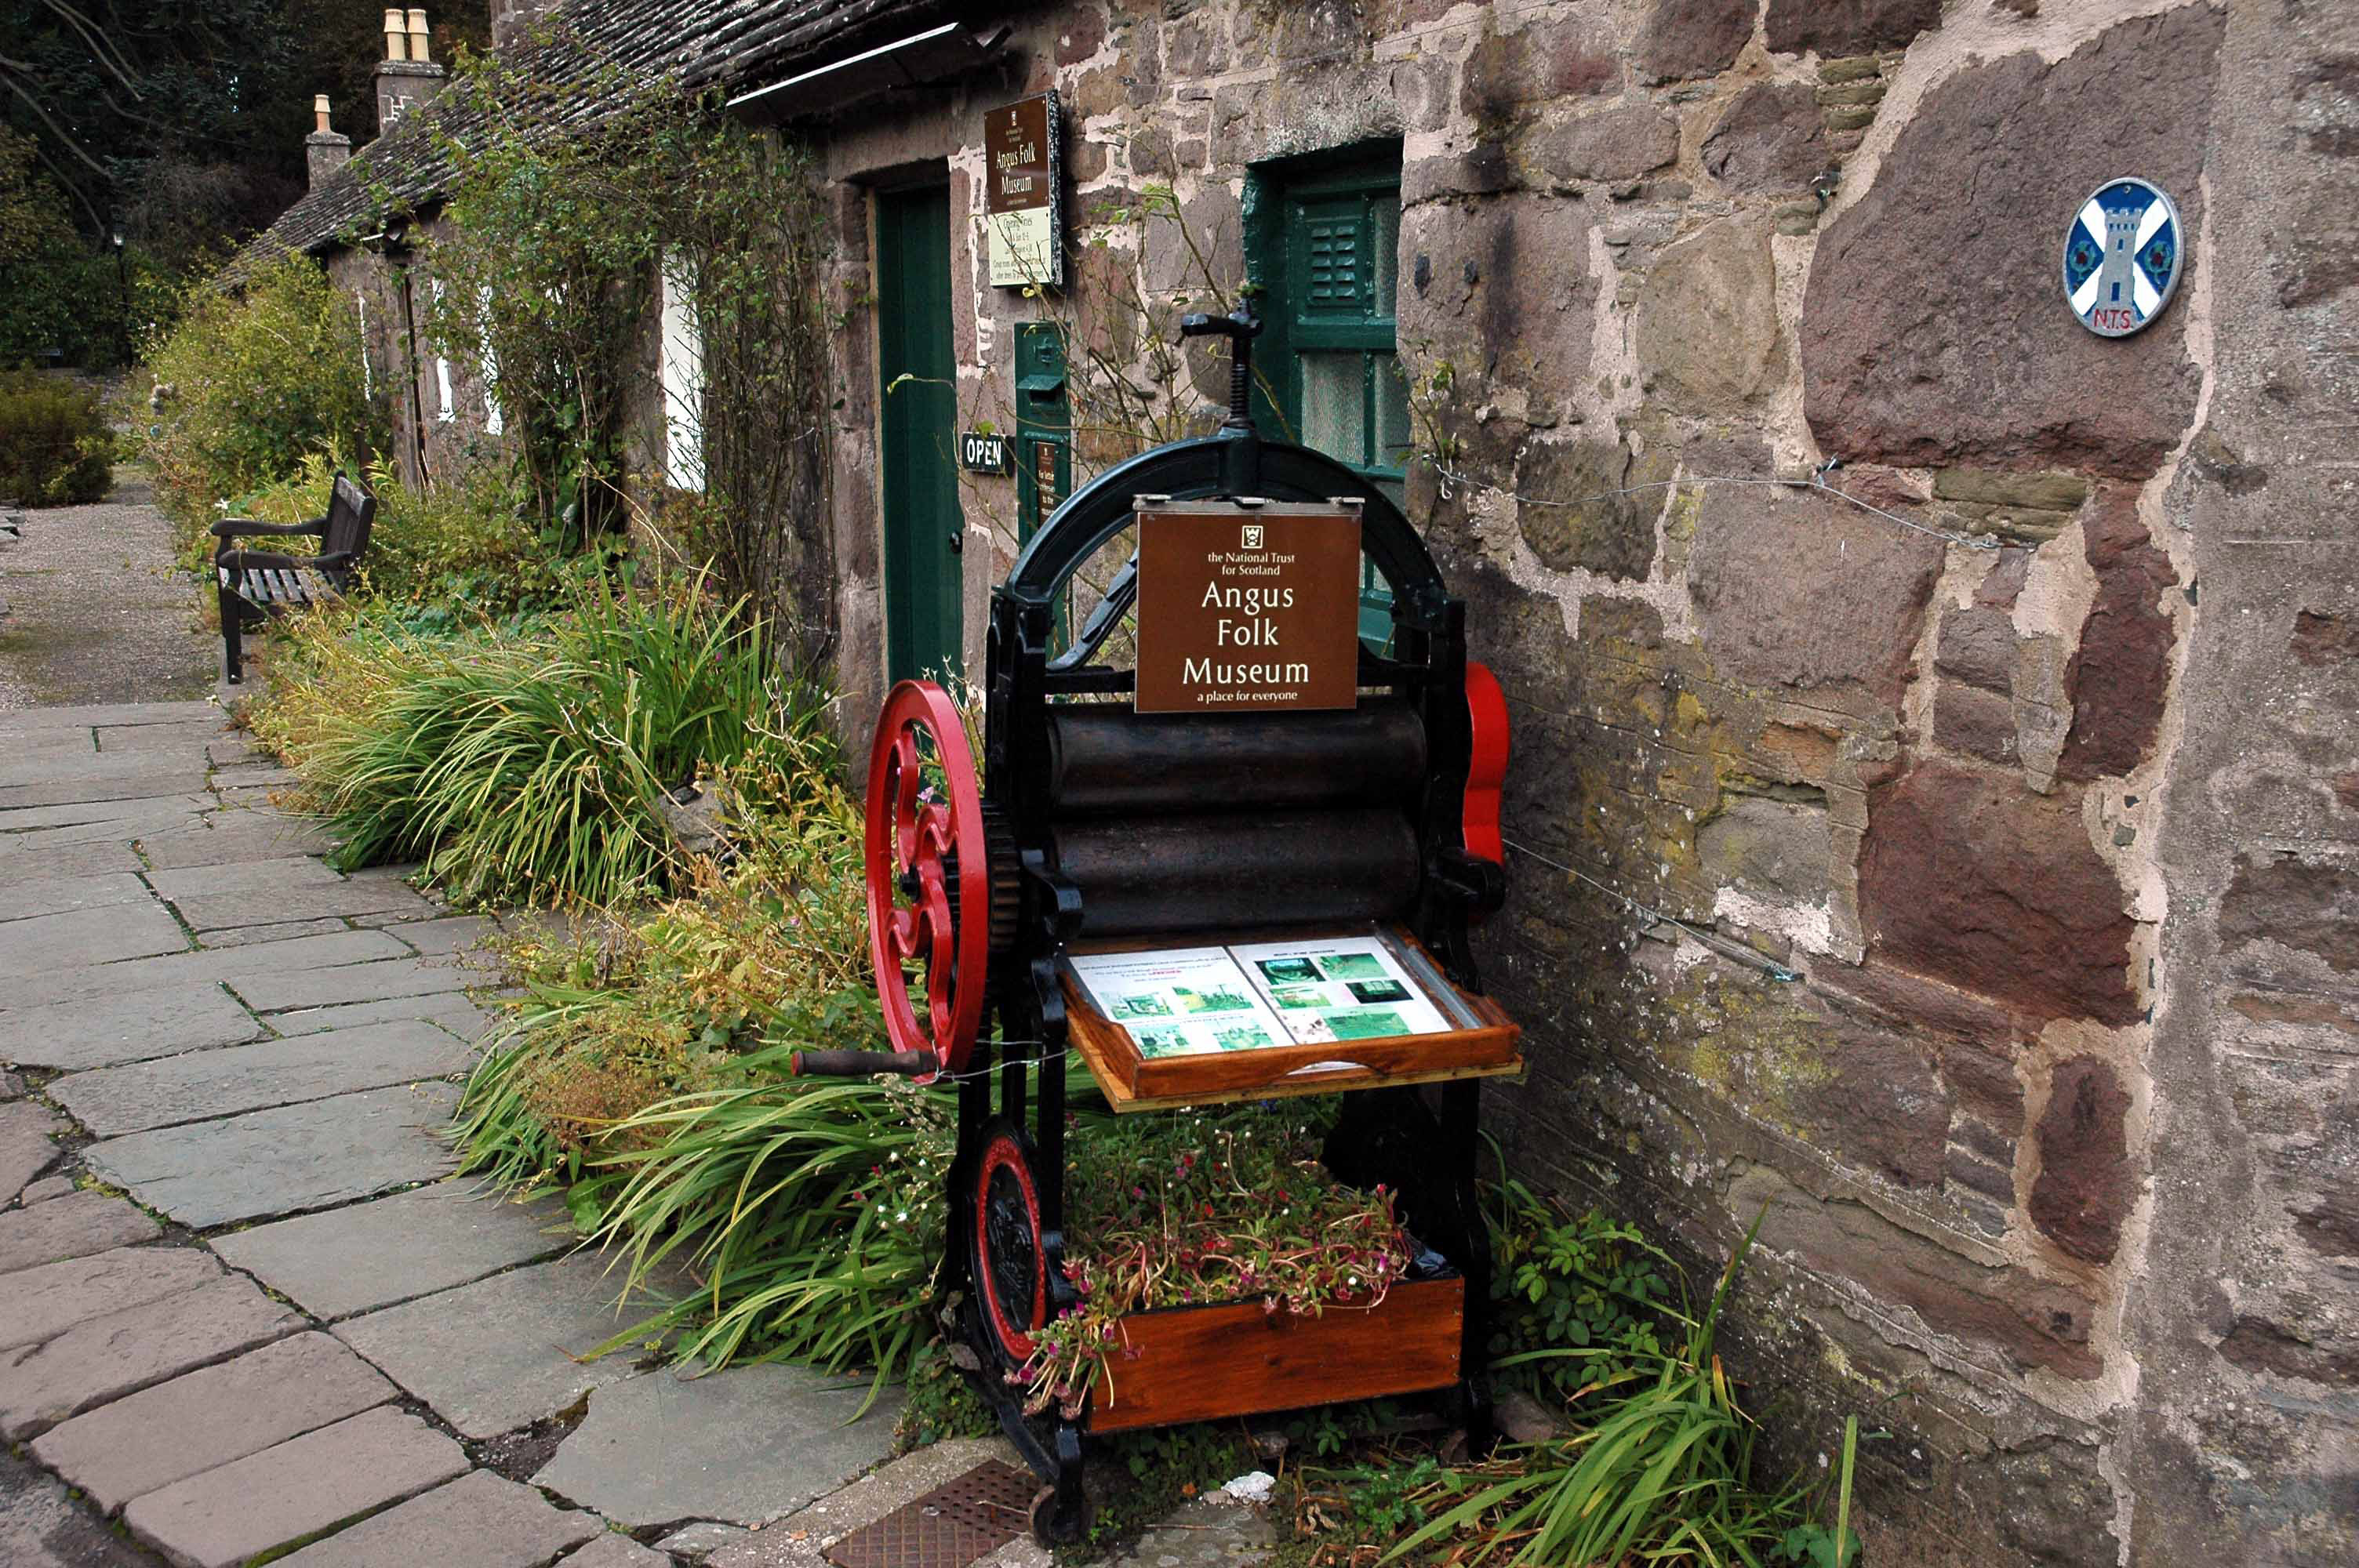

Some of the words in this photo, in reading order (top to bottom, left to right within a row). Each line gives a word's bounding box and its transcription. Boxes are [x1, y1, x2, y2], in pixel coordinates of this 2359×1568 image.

[996, 149, 1018, 172] Angus
[1020, 142, 1036, 164] Folk
[1001, 175, 1032, 195] Museum
[967, 438, 1001, 465] OPEN
[1208, 553, 1223, 563] the
[1226, 553, 1268, 563] National
[1270, 553, 1296, 563] Trust
[1222, 565, 1238, 575] for
[1239, 565, 1281, 575] Scotland
[1201, 580, 1294, 615] Angus
[1217, 617, 1279, 646] Folk
[1182, 658, 1310, 684] Museum
[1197, 693, 1204, 702] a
[1206, 691, 1234, 704] place
[1236, 690, 1250, 702] for
[1252, 691, 1298, 703] everyone
